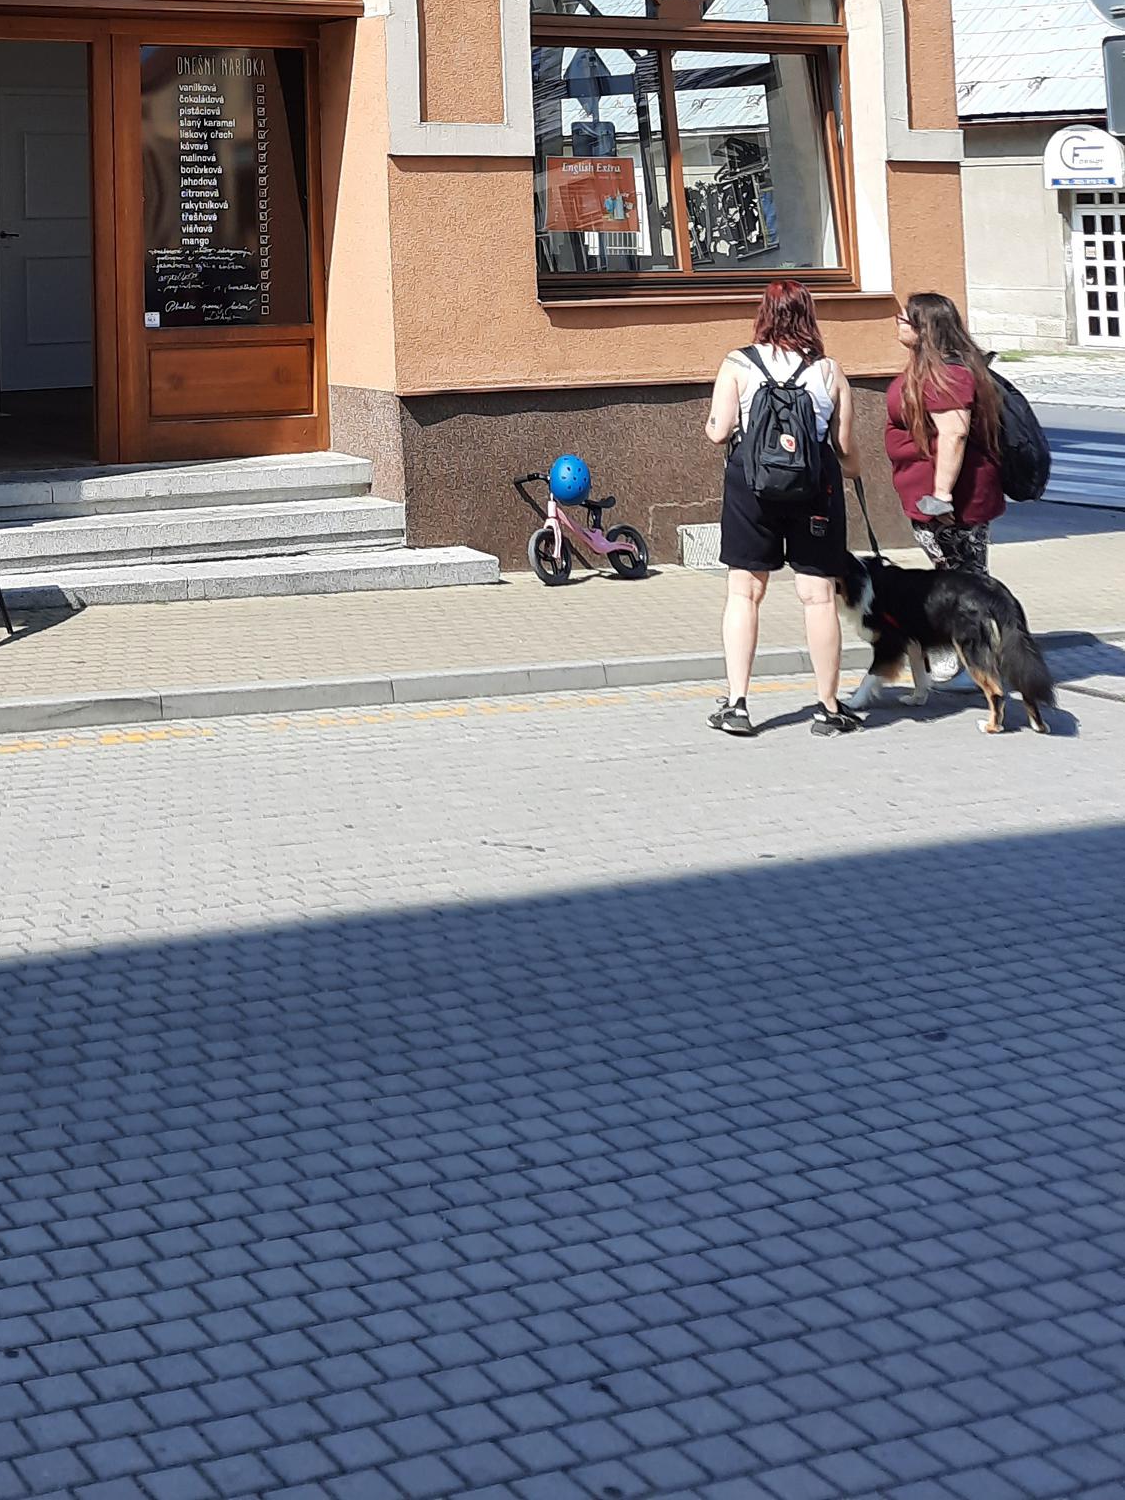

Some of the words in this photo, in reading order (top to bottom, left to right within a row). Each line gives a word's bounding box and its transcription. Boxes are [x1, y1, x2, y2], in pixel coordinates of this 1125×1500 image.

[177, 54, 215, 76] DNEŠNÍ
[221, 55, 266, 77] NABÍDKA
[178, 94, 225, 104] čokoládová
[179, 106, 221, 117] pistáciová
[179, 117, 202, 128] slaný
[203, 118, 236, 128] karamel
[180, 141, 209, 151] kávová
[180, 153, 217, 163] malinová
[180, 165, 223, 174] borůvková
[562, 162, 594, 175] English
[596, 162, 621, 174] Extra
[180, 176, 218, 188] jahodová
[181, 224, 214, 234] višňová
[181, 237, 210, 247] mango
